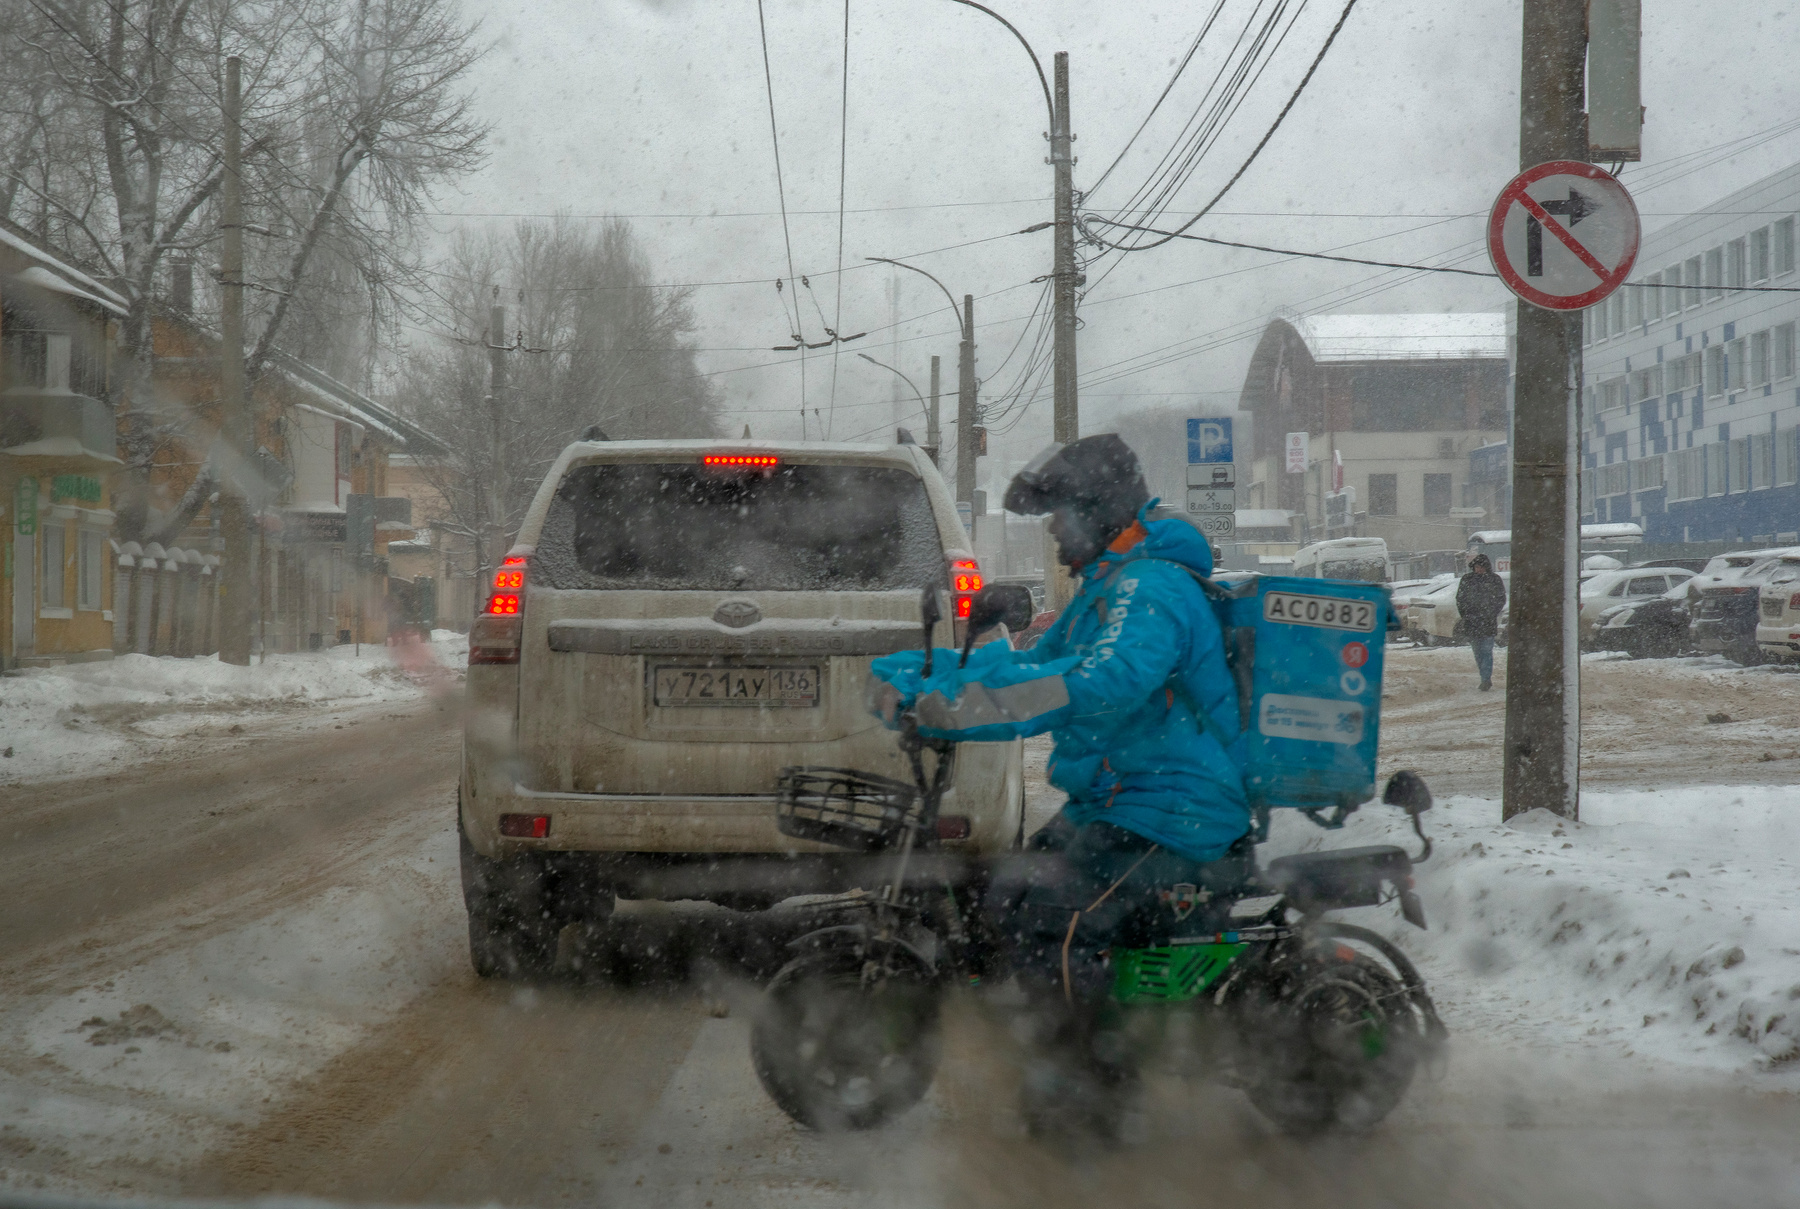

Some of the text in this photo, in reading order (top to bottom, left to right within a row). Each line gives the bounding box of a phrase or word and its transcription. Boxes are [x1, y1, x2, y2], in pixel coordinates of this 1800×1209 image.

[1199, 422, 1225, 459] P
[1190, 502, 1233, 511] 8.00-19.00
[1216, 520, 1230, 531] 20
[1270, 598, 1370, 627] AC0882
[773, 671, 810, 691] 136
[780, 690, 799, 699] RUS
